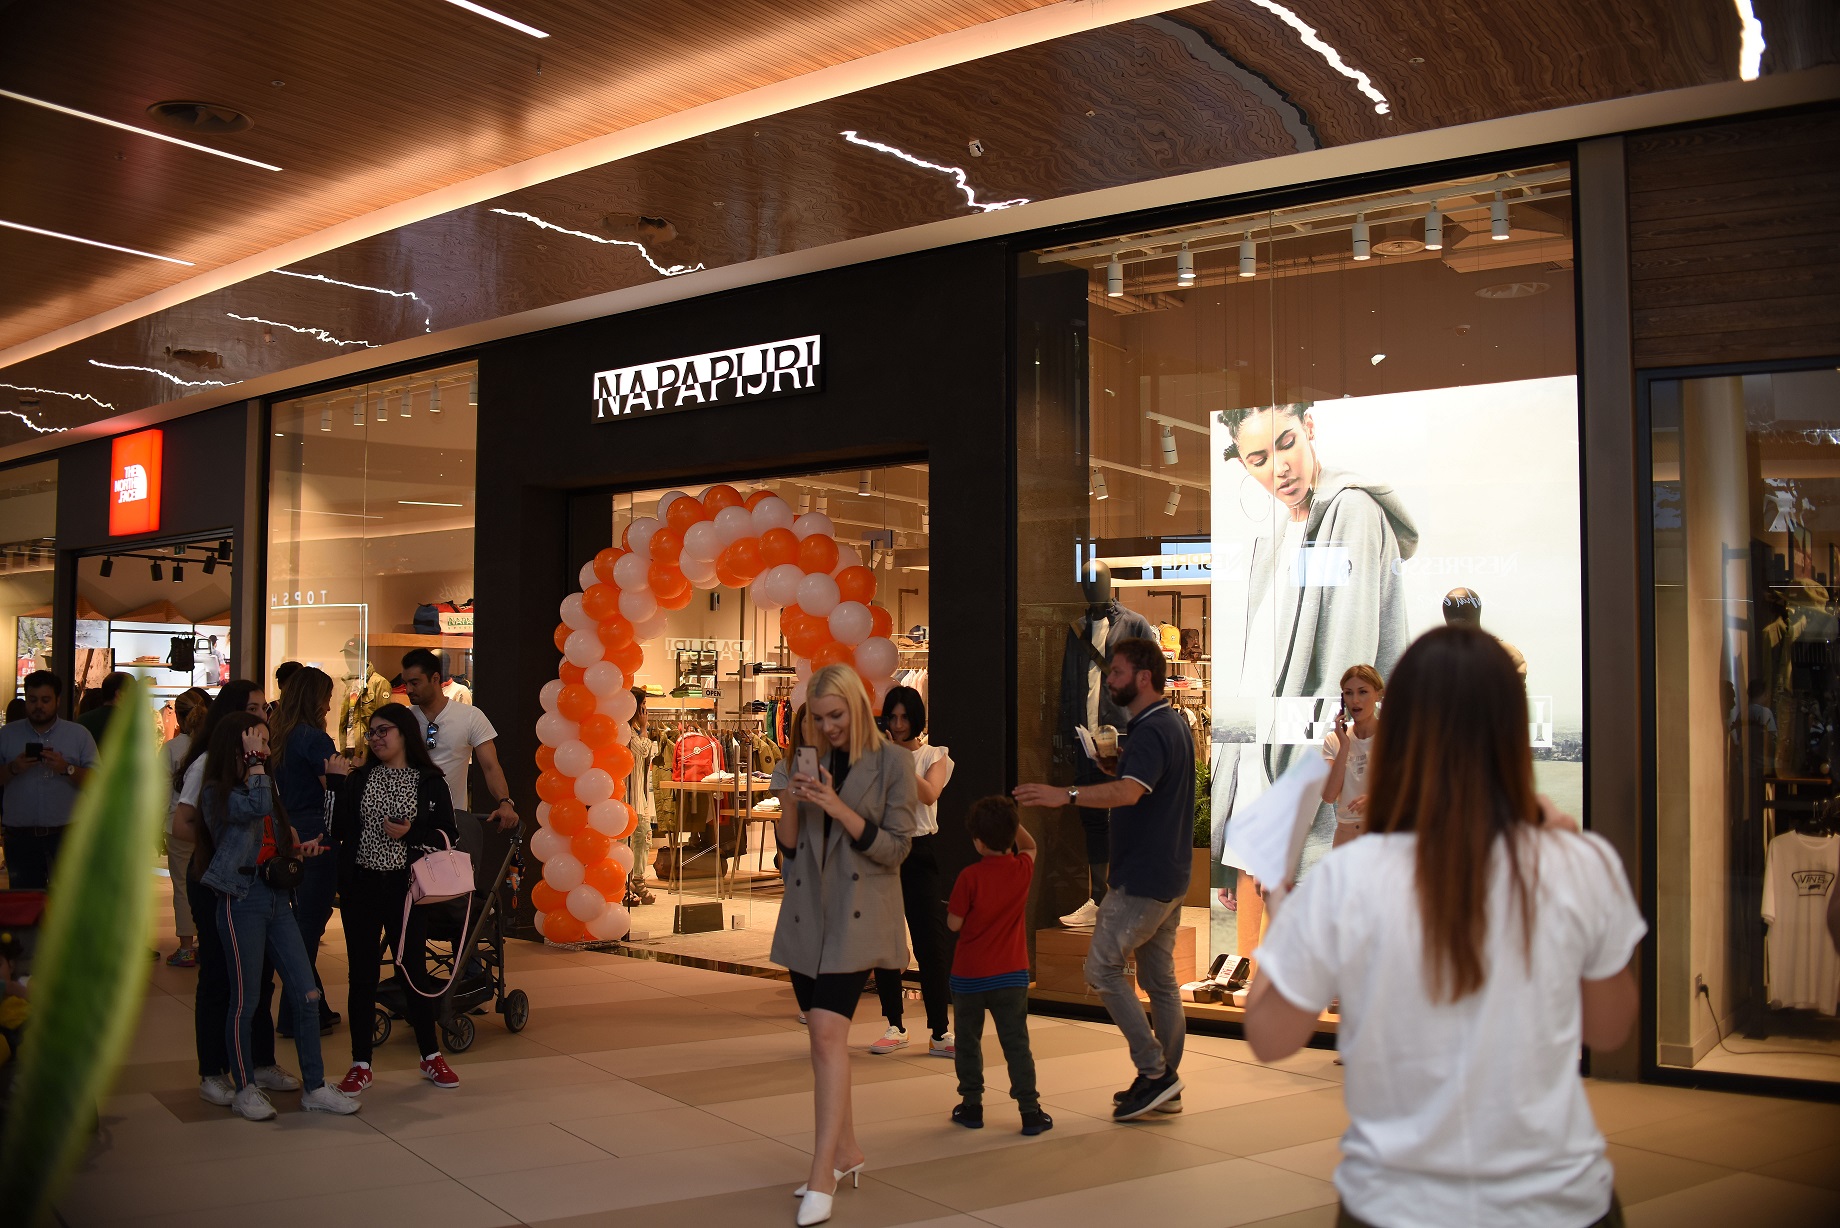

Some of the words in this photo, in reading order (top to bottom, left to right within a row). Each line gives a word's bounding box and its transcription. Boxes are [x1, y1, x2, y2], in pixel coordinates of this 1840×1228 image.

[597, 341, 816, 418] NAPAPIJRI
[124, 465, 138, 478] THE
[114, 477, 138, 492] NORTH
[118, 490, 137, 503] FACE
